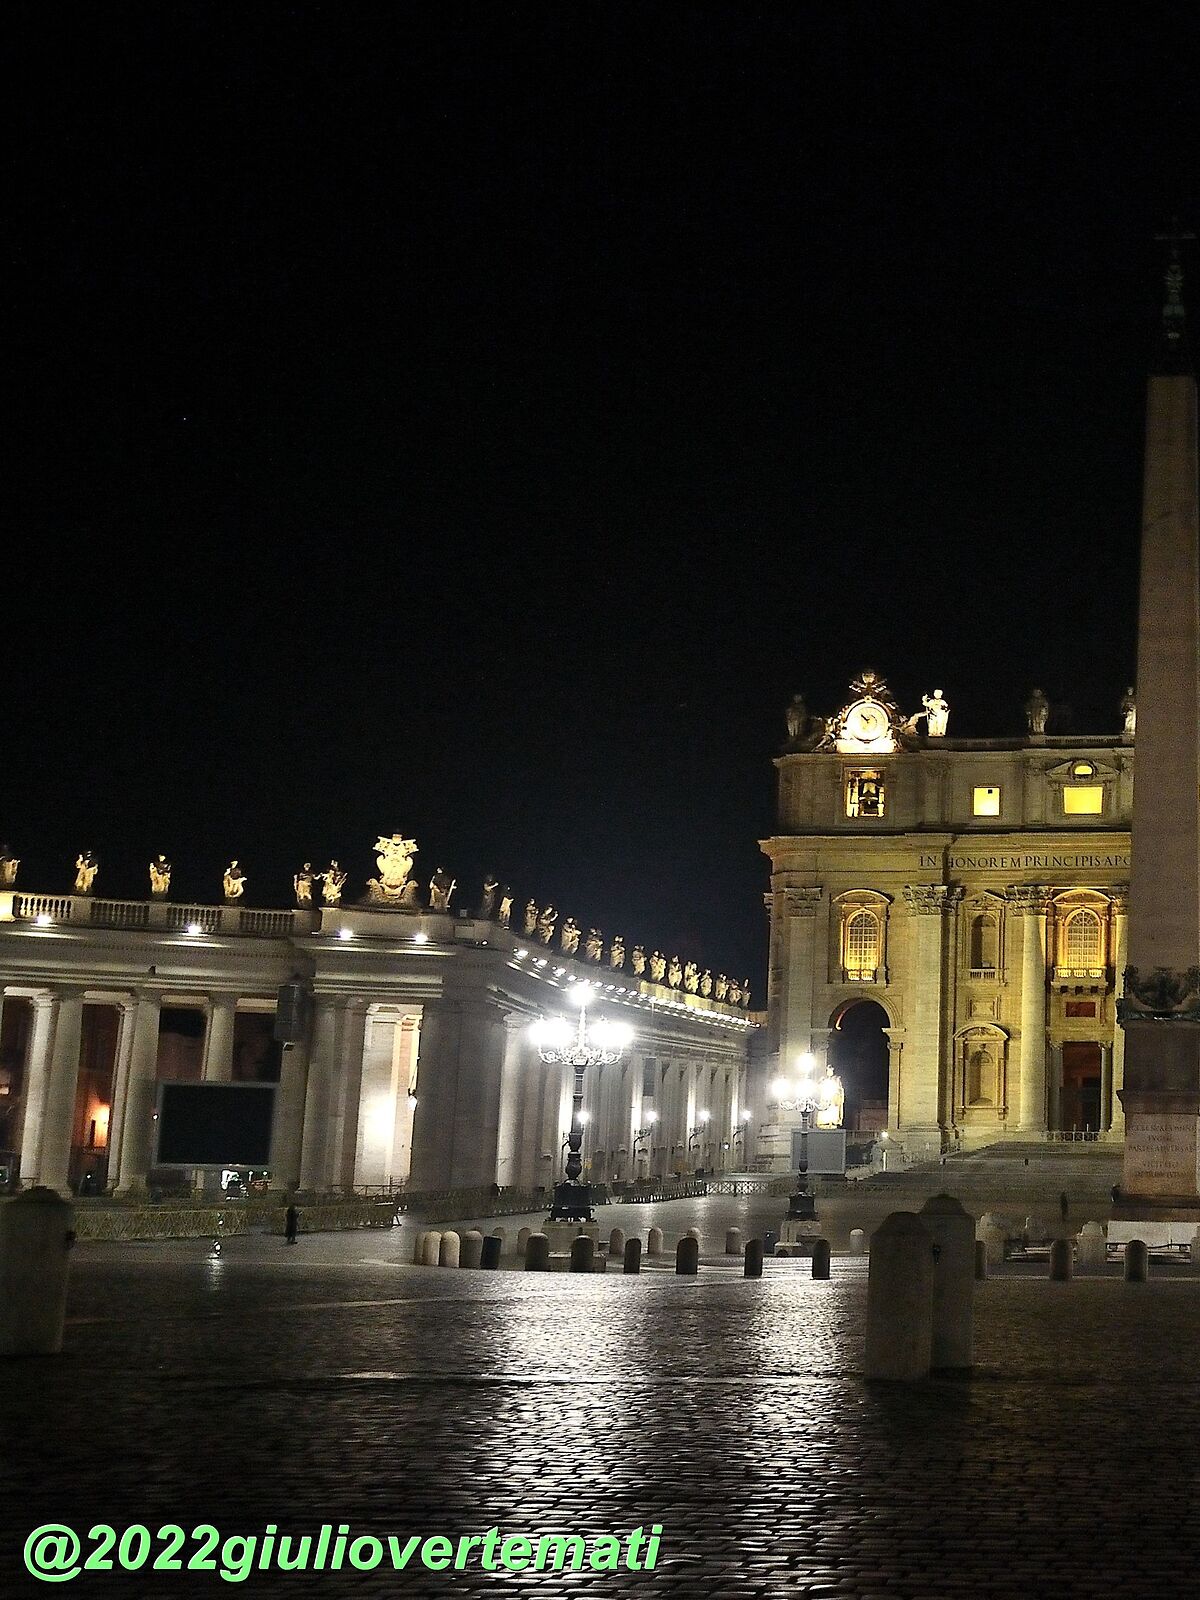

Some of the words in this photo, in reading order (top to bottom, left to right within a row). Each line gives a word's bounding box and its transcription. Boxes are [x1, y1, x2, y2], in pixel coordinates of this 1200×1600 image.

[919, 855, 937, 867] IN
[945, 857, 1021, 868] HONOREM
[1024, 855, 1101, 867] PRINCIPIS
